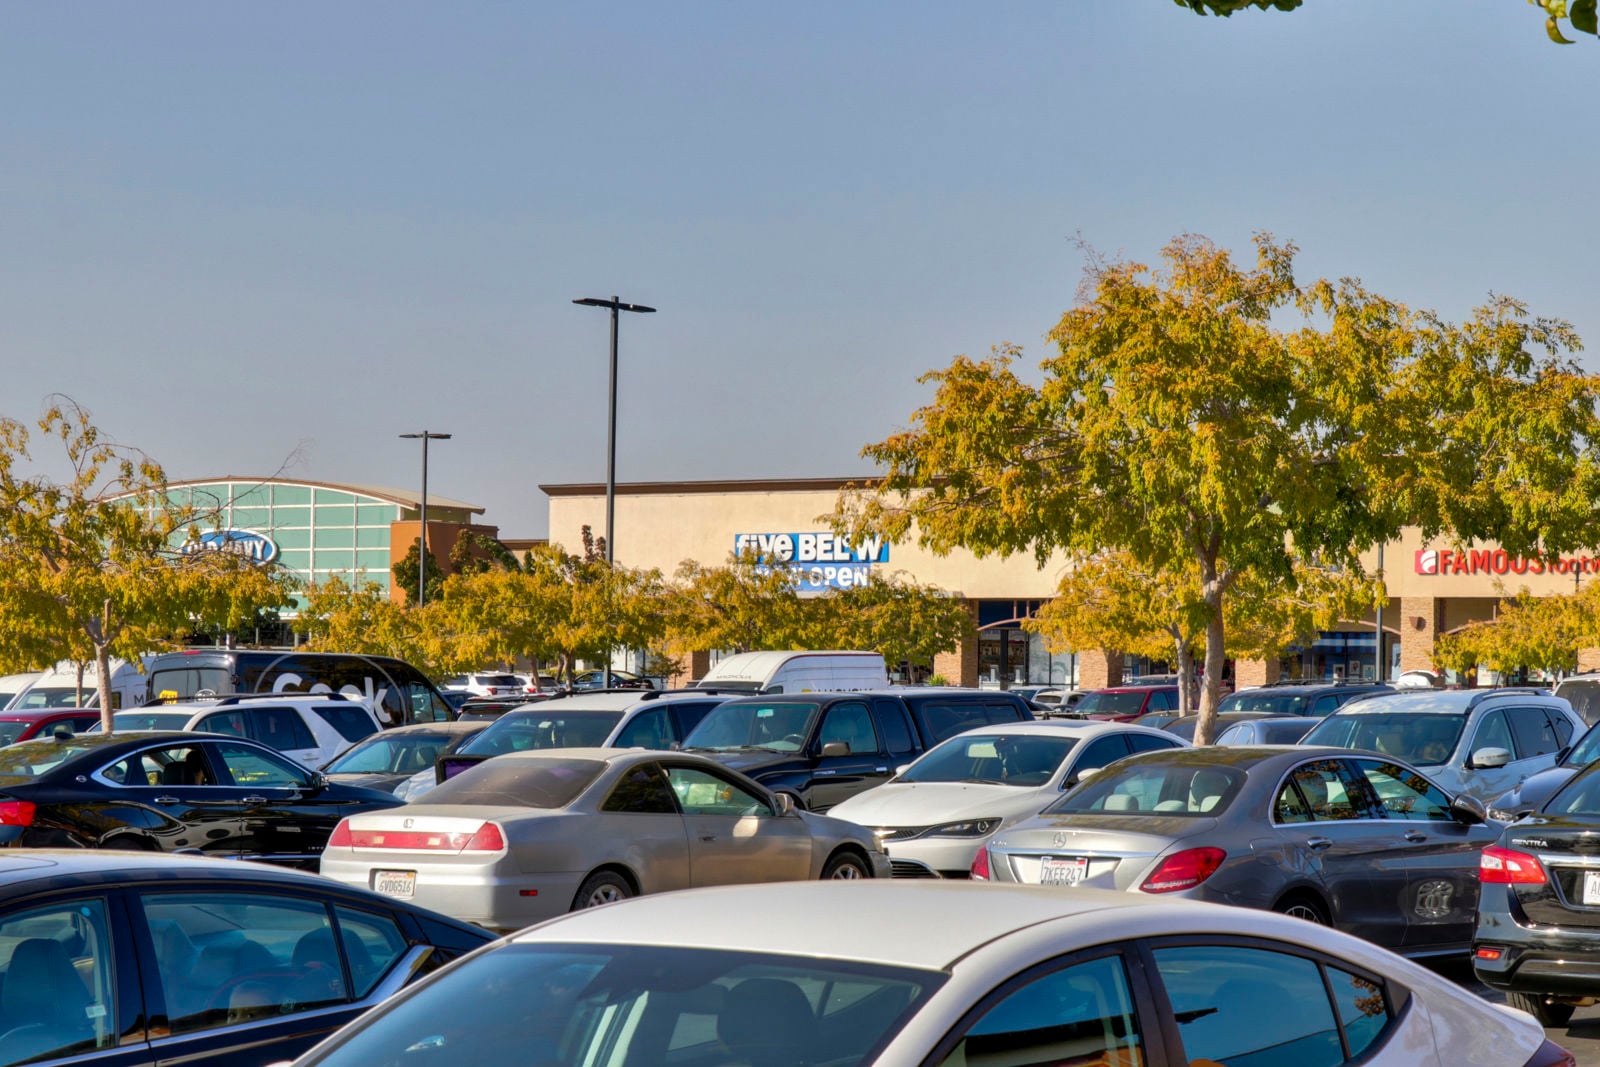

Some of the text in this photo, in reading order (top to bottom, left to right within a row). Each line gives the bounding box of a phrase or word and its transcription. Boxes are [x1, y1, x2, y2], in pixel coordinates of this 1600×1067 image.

[1439, 549, 1544, 574] FAMOUS
[1512, 838, 1548, 848] SENTRA
[1043, 866, 1083, 881] 7KEE247
